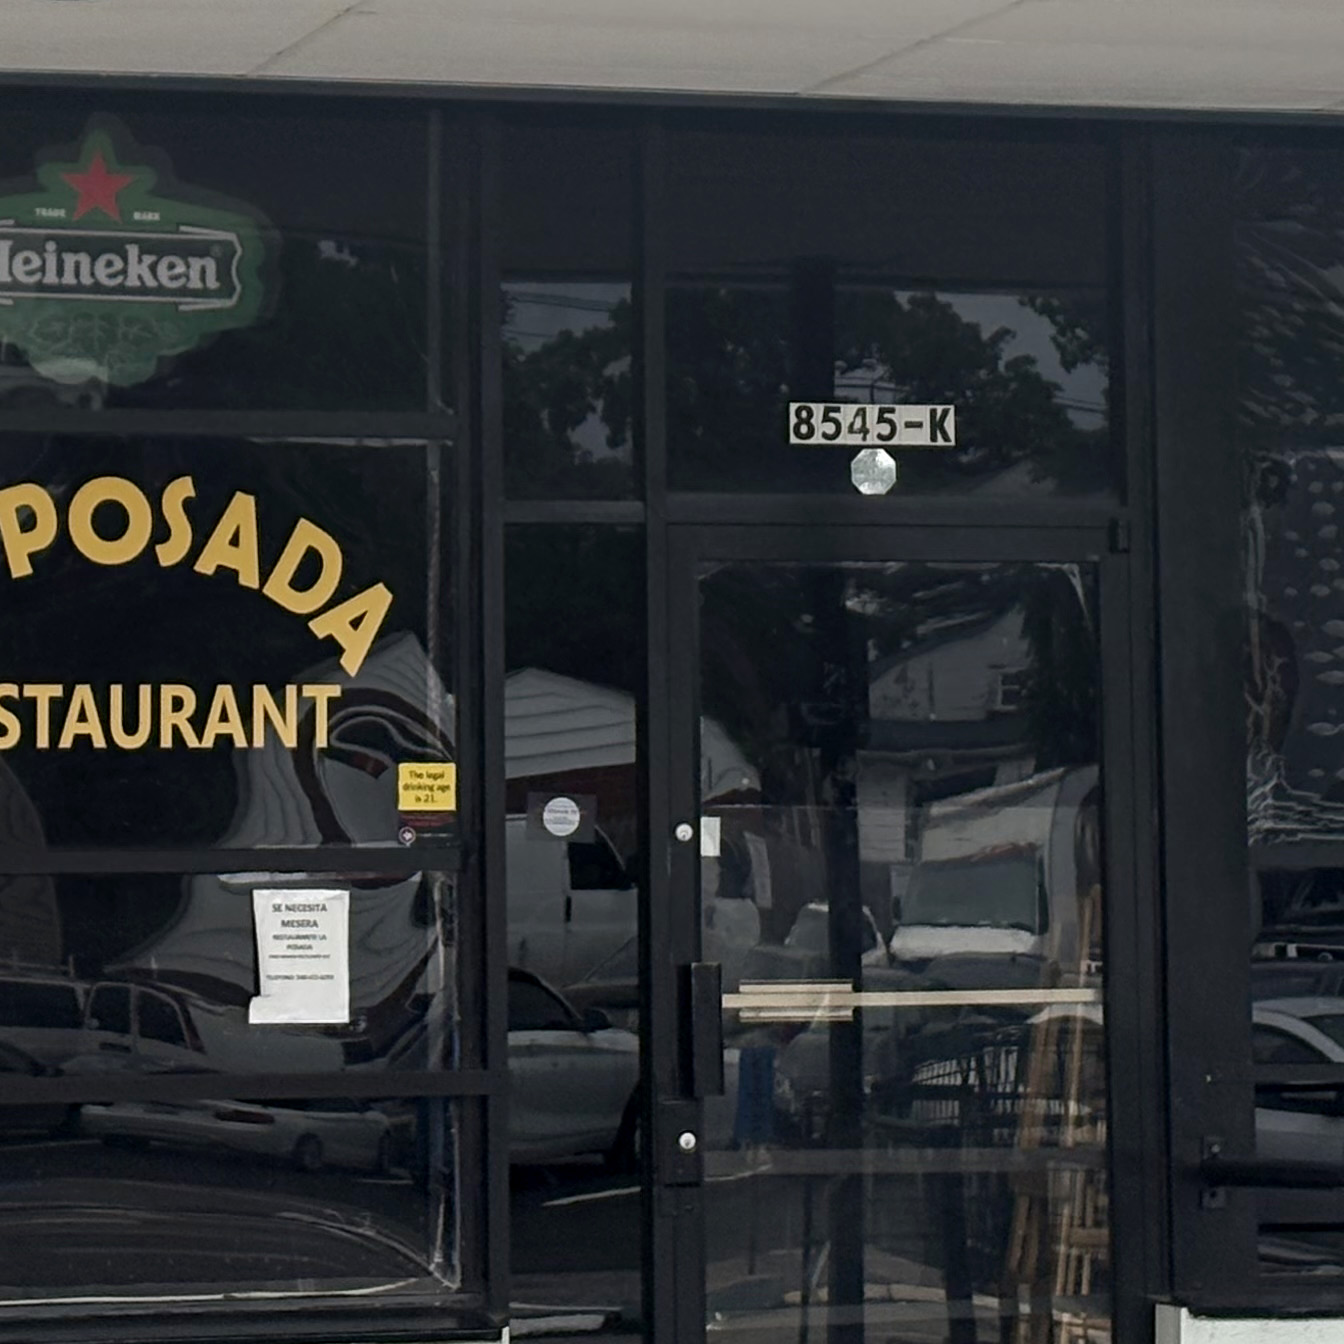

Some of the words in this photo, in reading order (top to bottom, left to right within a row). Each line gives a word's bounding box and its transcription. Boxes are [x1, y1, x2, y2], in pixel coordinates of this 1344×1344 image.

[792, 405, 953, 444] 8545-K
[408, 769, 424, 779] The
[425, 769, 445, 781] legal
[284, 903, 327, 912] NECESITA
